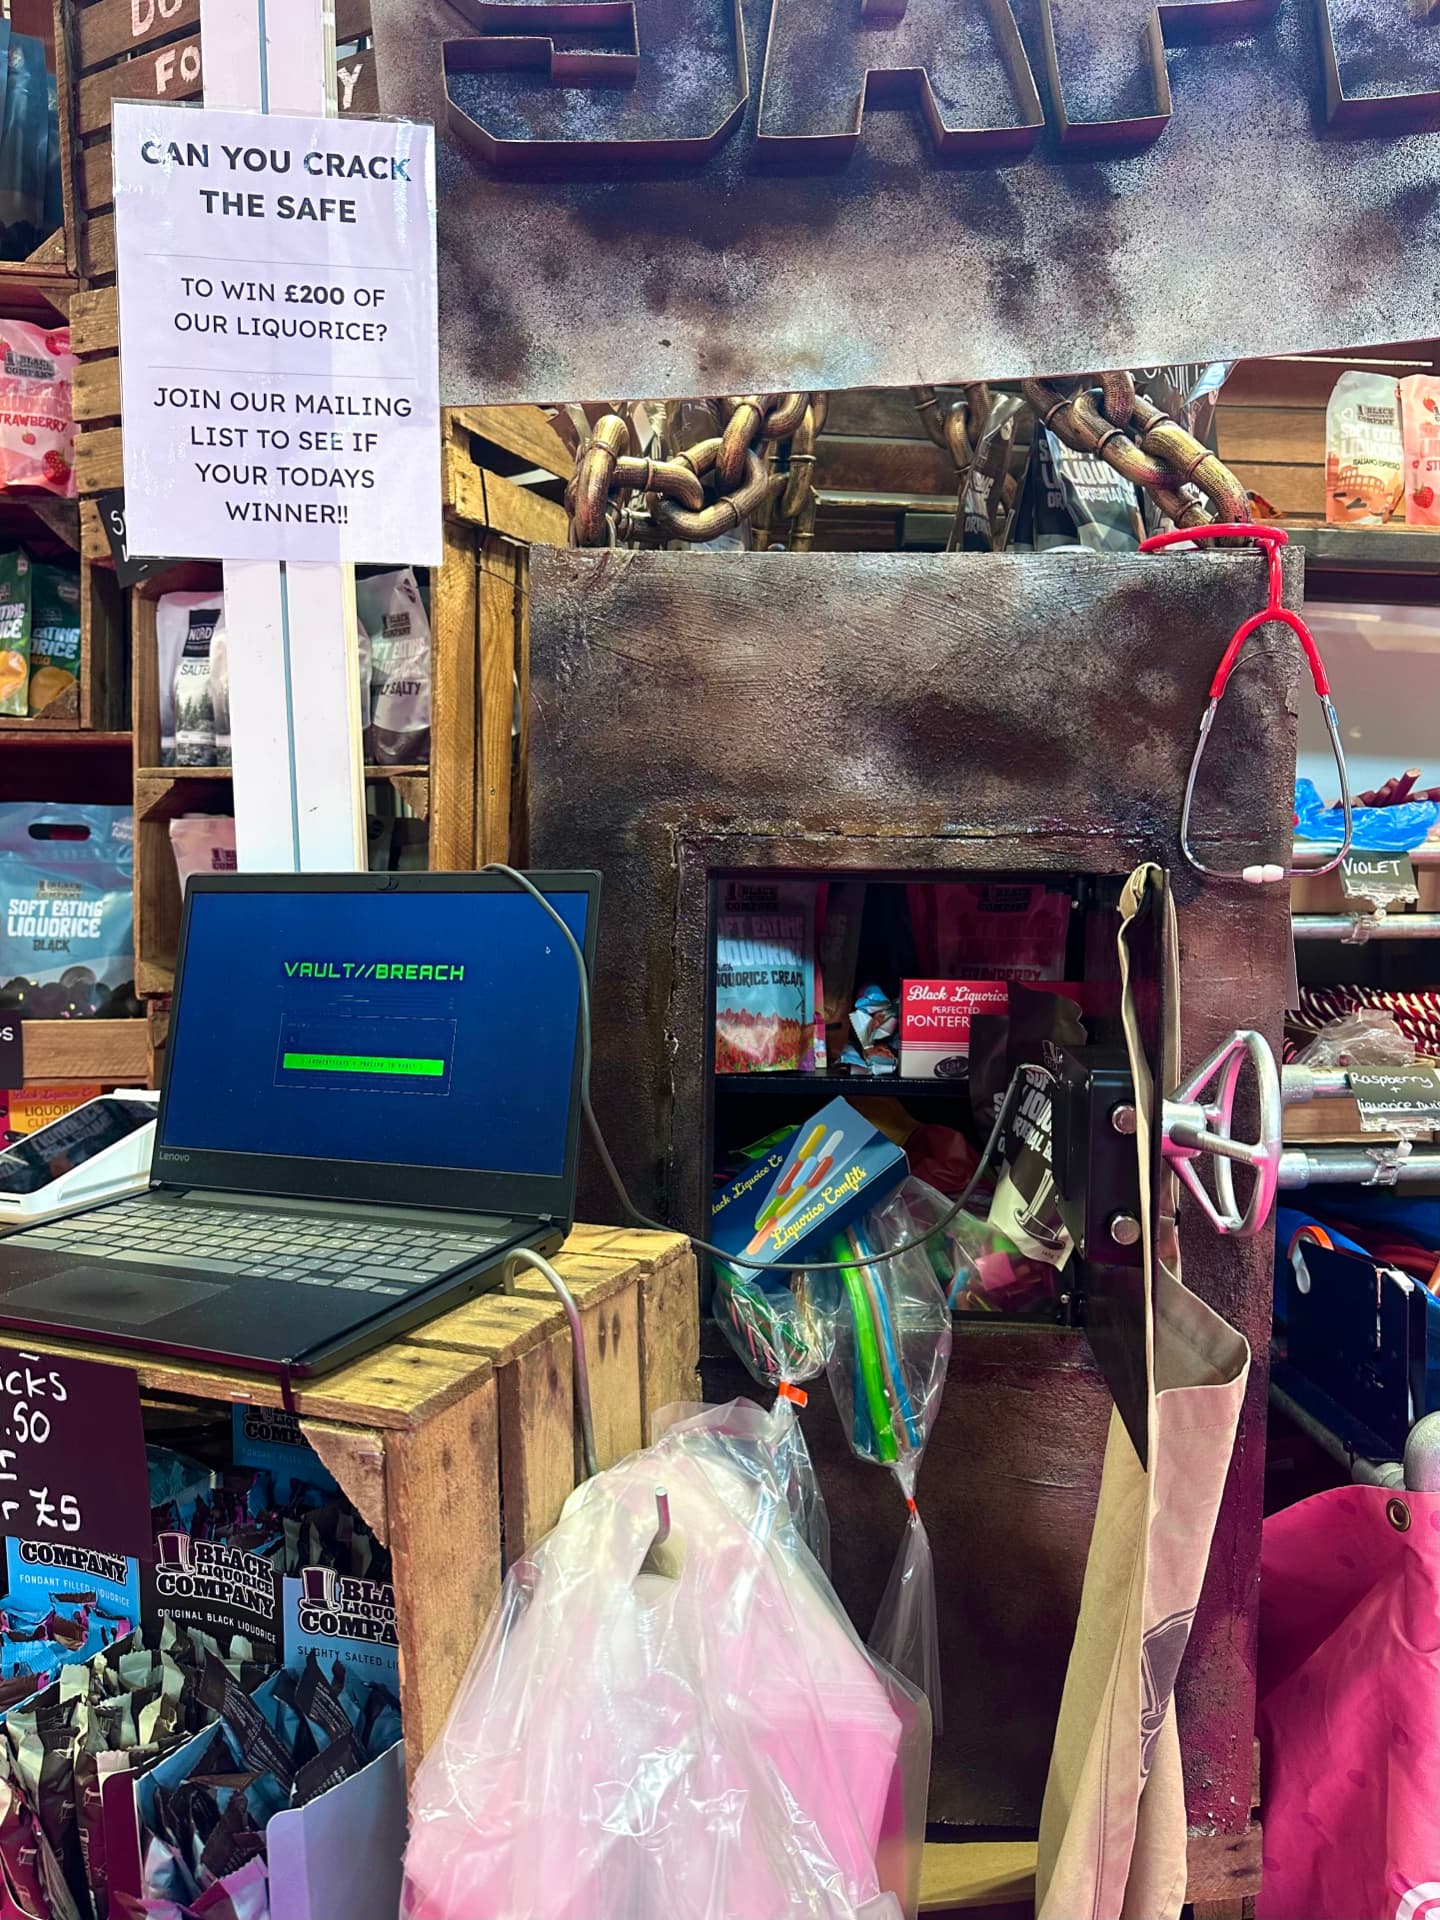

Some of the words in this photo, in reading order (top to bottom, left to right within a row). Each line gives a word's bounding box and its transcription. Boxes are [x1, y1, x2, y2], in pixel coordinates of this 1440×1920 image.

[141, 141, 209, 168] CAN
[221, 145, 291, 173] YOU
[304, 151, 412, 182] CRACK
[200, 189, 265, 218] THE
[277, 195, 357, 223] SAFE
[182, 277, 213, 298] TO
[221, 280, 275, 302] WIN
[284, 284, 345, 305] £200
[353, 288, 385, 307] OF
[174, 312, 228, 334] OUR
[237, 316, 388, 342] LIQUORICE?
[153, 387, 221, 410] JOIN
[230, 391, 286, 413] OUR
[296, 394, 412, 417] MAILING
[191, 425, 249, 449] LIST
[256, 429, 290, 450] TO
[299, 431, 343, 451] SEE
[352, 433, 378, 452] IF
[195, 463, 268, 485] YOUR
[277, 466, 375, 489] TODAYS
[225, 501, 349, 524] WINNER!!
[1342, 858, 1401, 876] VIOLET
[8, 899, 48, 917] SOFT
[52, 899, 103, 918] EATING
[7, 917, 102, 939] LIQUORICE
[32, 938, 71, 953] BLACK
[284, 962, 465, 981] VAULT//BREACH
[907, 984, 948, 1001] Black
[950, 986, 1009, 1006] Liquorice
[932, 1005, 980, 1015] PERFECTED
[1350, 1072, 1434, 1088] Raspberry
[158, 1151, 190, 1163] Lenovo
[769, 1203, 825, 1250] Liquorice
[821, 1165, 867, 1205] Comfits
[20, 1541, 128, 1585] COMPANY
[194, 1541, 274, 1582] BLACK
[19, 1574, 60, 1588] FONDANT
[197, 1561, 274, 1597] LIQUORICE
[157, 1574, 276, 1619] COMPANY
[207, 1612, 234, 1627] BLACK
[237, 1619, 277, 1644] LIQUORICE
[345, 1651, 383, 1667] SALTED
